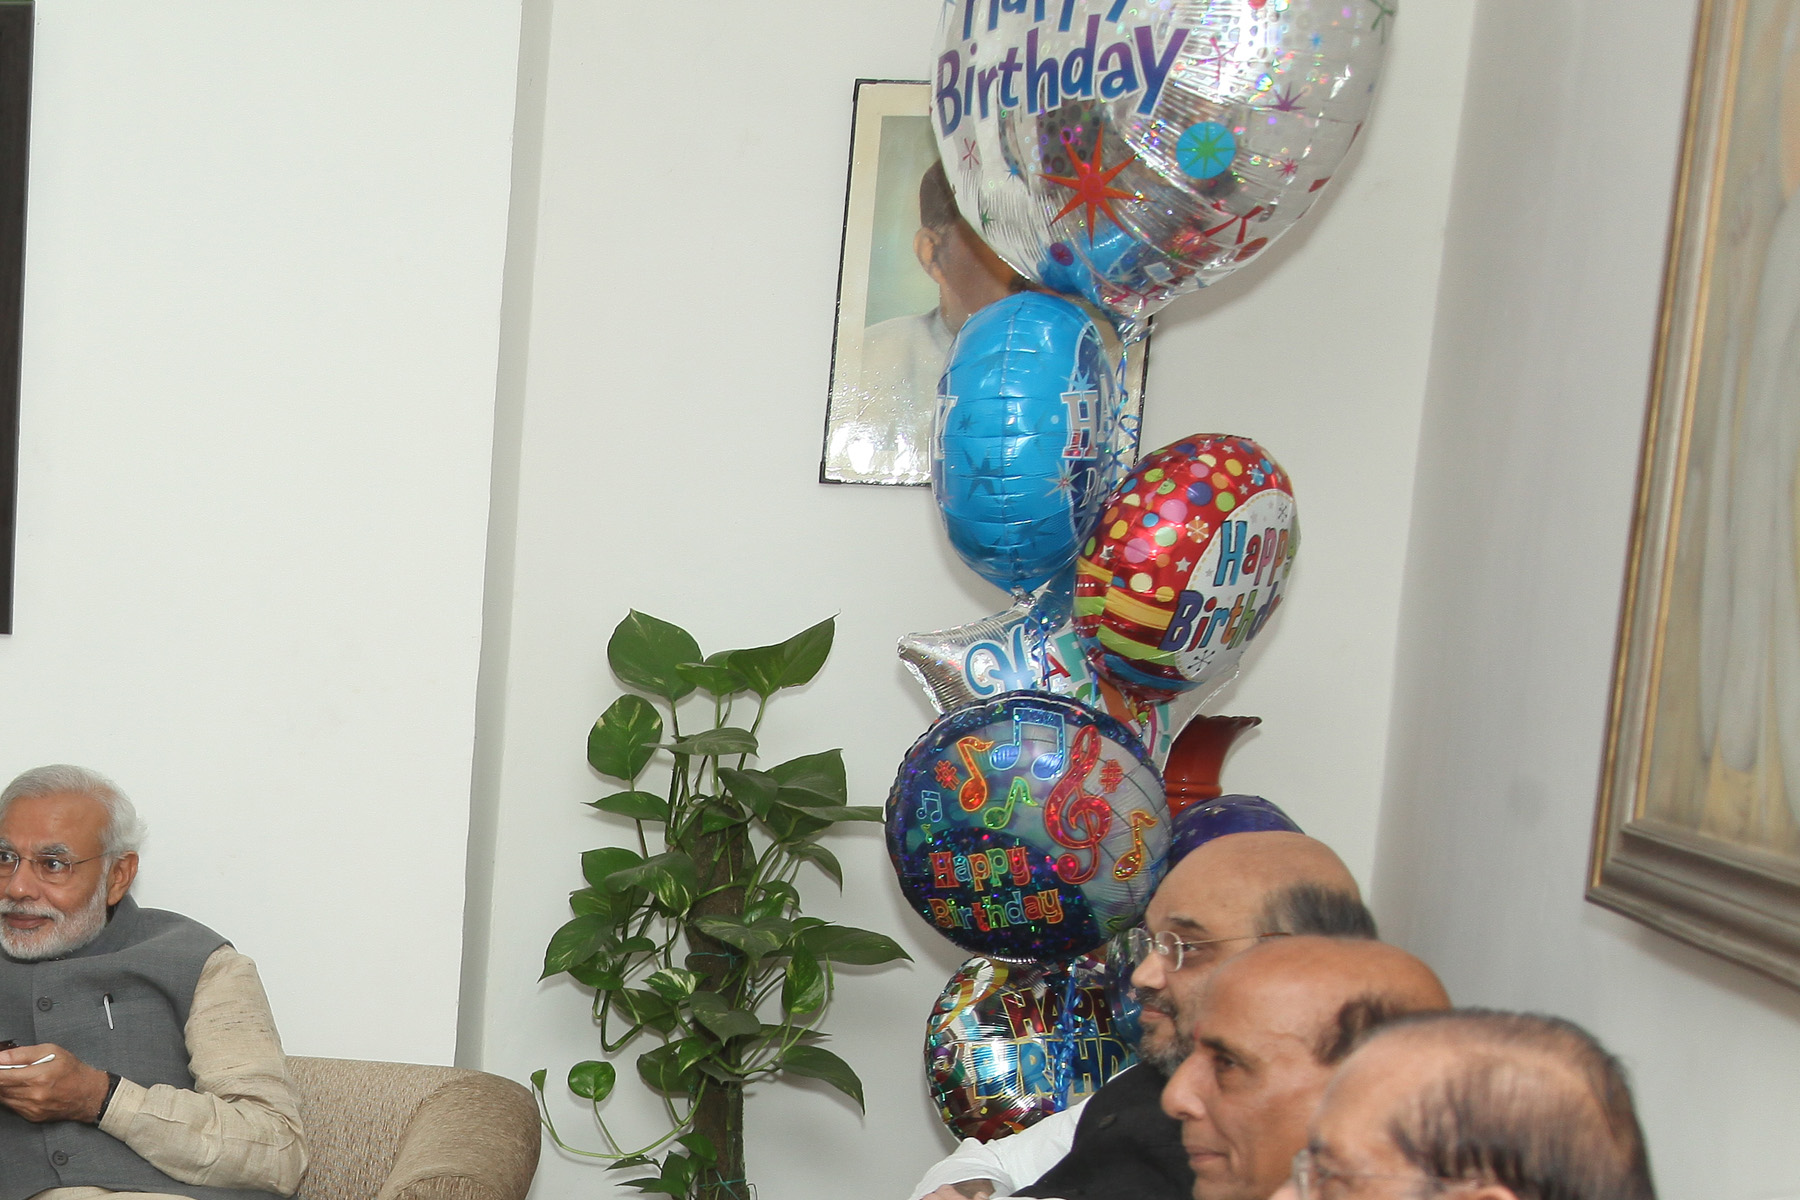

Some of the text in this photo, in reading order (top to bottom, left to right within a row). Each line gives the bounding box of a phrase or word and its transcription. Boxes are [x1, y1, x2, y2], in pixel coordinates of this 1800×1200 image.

[937, 14, 1190, 138] Birthday
[929, 846, 1031, 892] Happy
[928, 888, 1064, 933] Birthday
[1001, 986, 1113, 1040] HAPP
